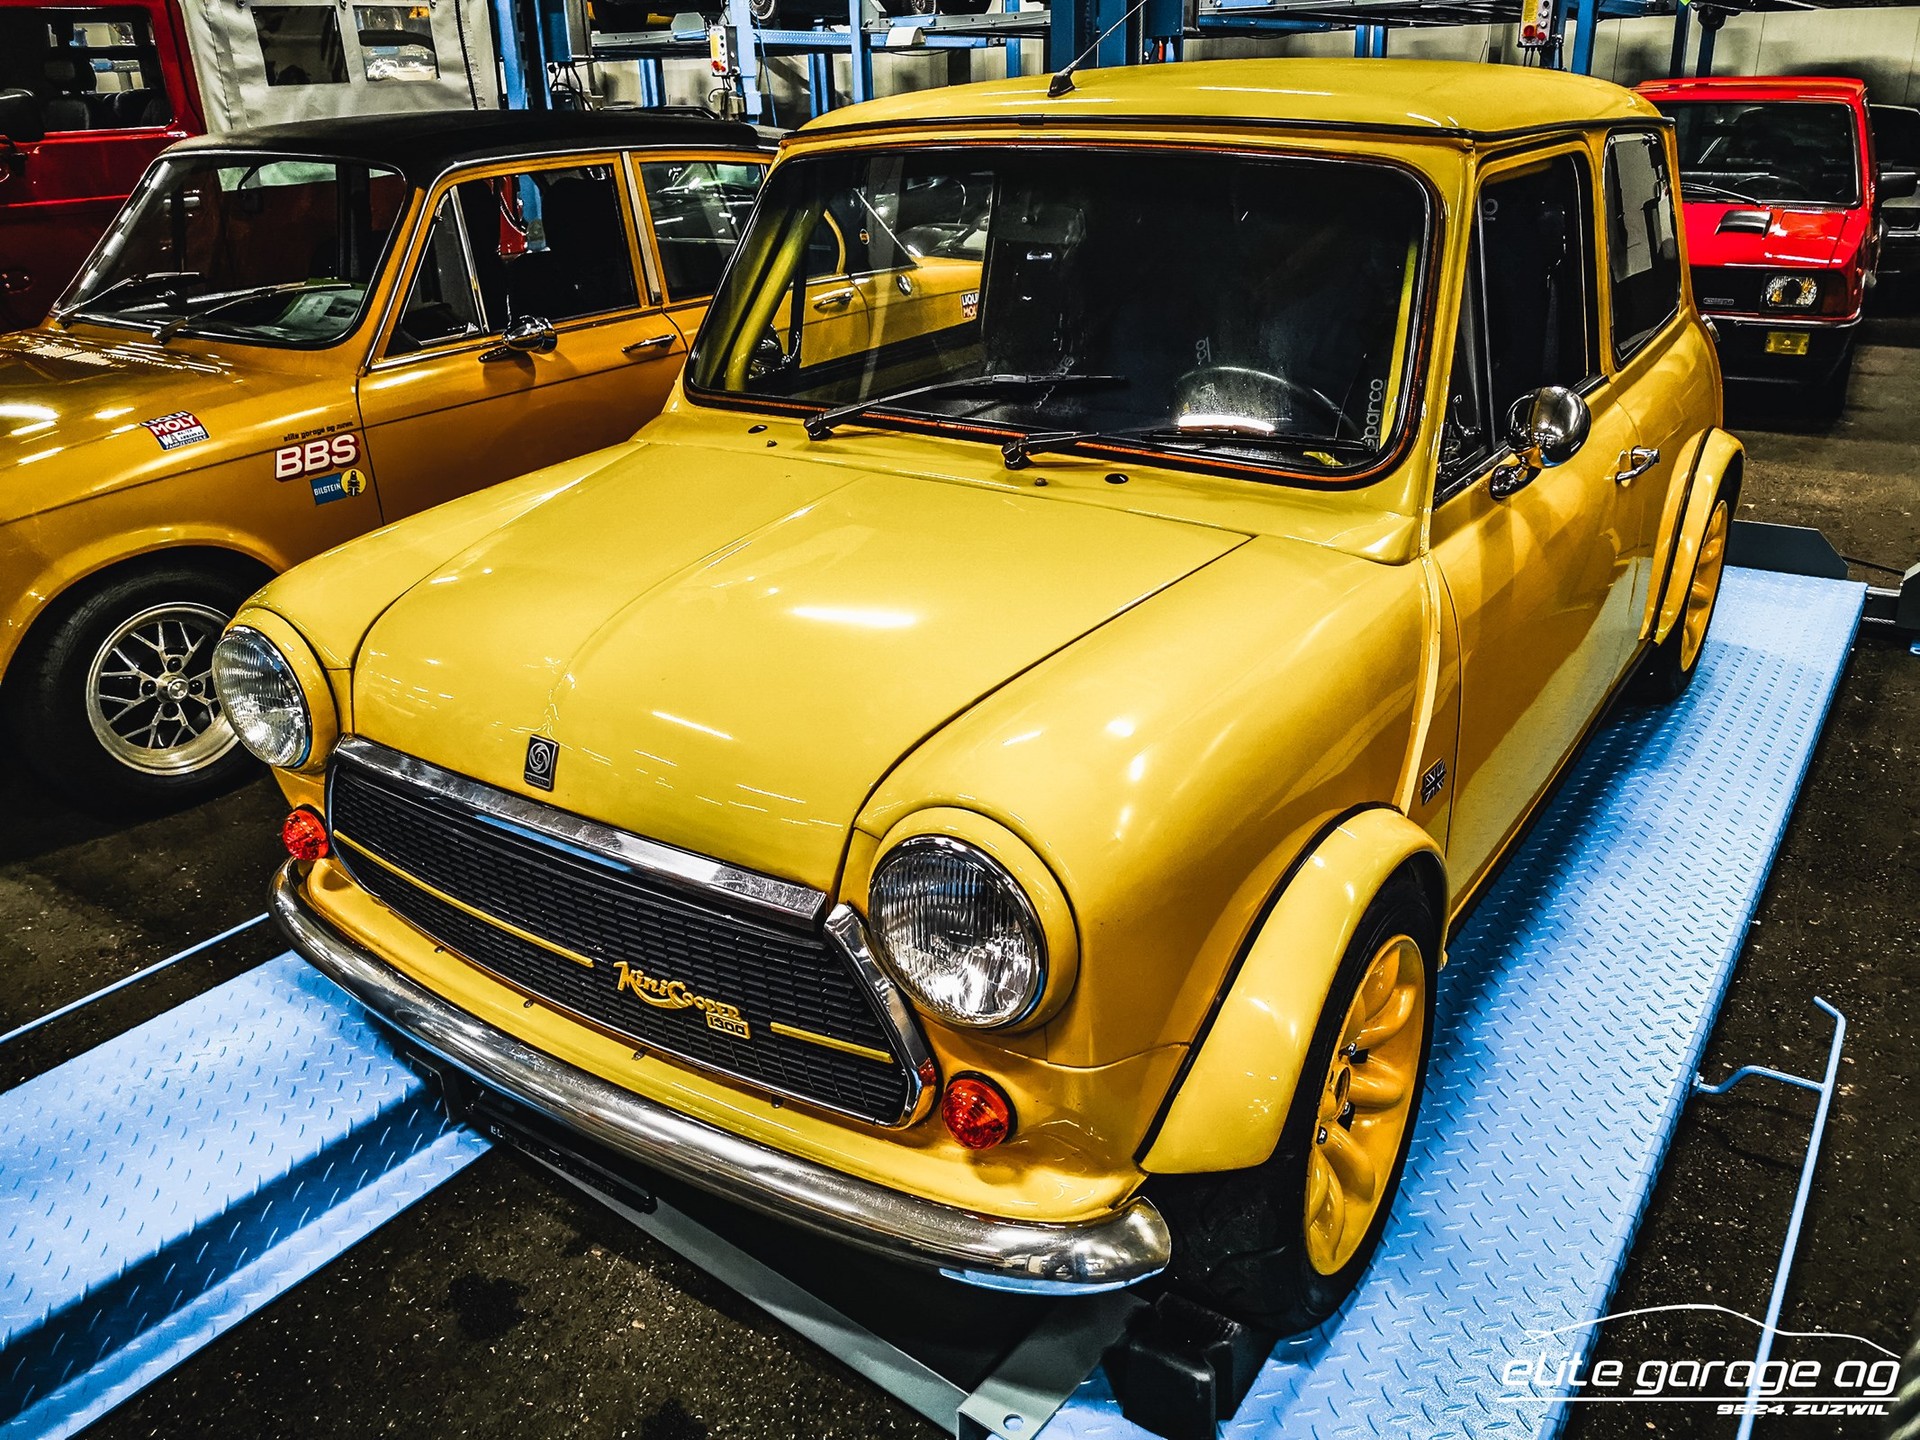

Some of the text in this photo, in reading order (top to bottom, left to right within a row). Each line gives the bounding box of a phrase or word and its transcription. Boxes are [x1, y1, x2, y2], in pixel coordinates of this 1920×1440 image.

[141, 411, 189, 427] LIQUI
[1365, 378, 1384, 451] sparco
[150, 415, 196, 435] MOLY
[301, 427, 325, 439] garage
[275, 434, 359, 481] BBS
[313, 482, 342, 496] BILSTEIN
[709, 1016, 746, 1035] 1300
